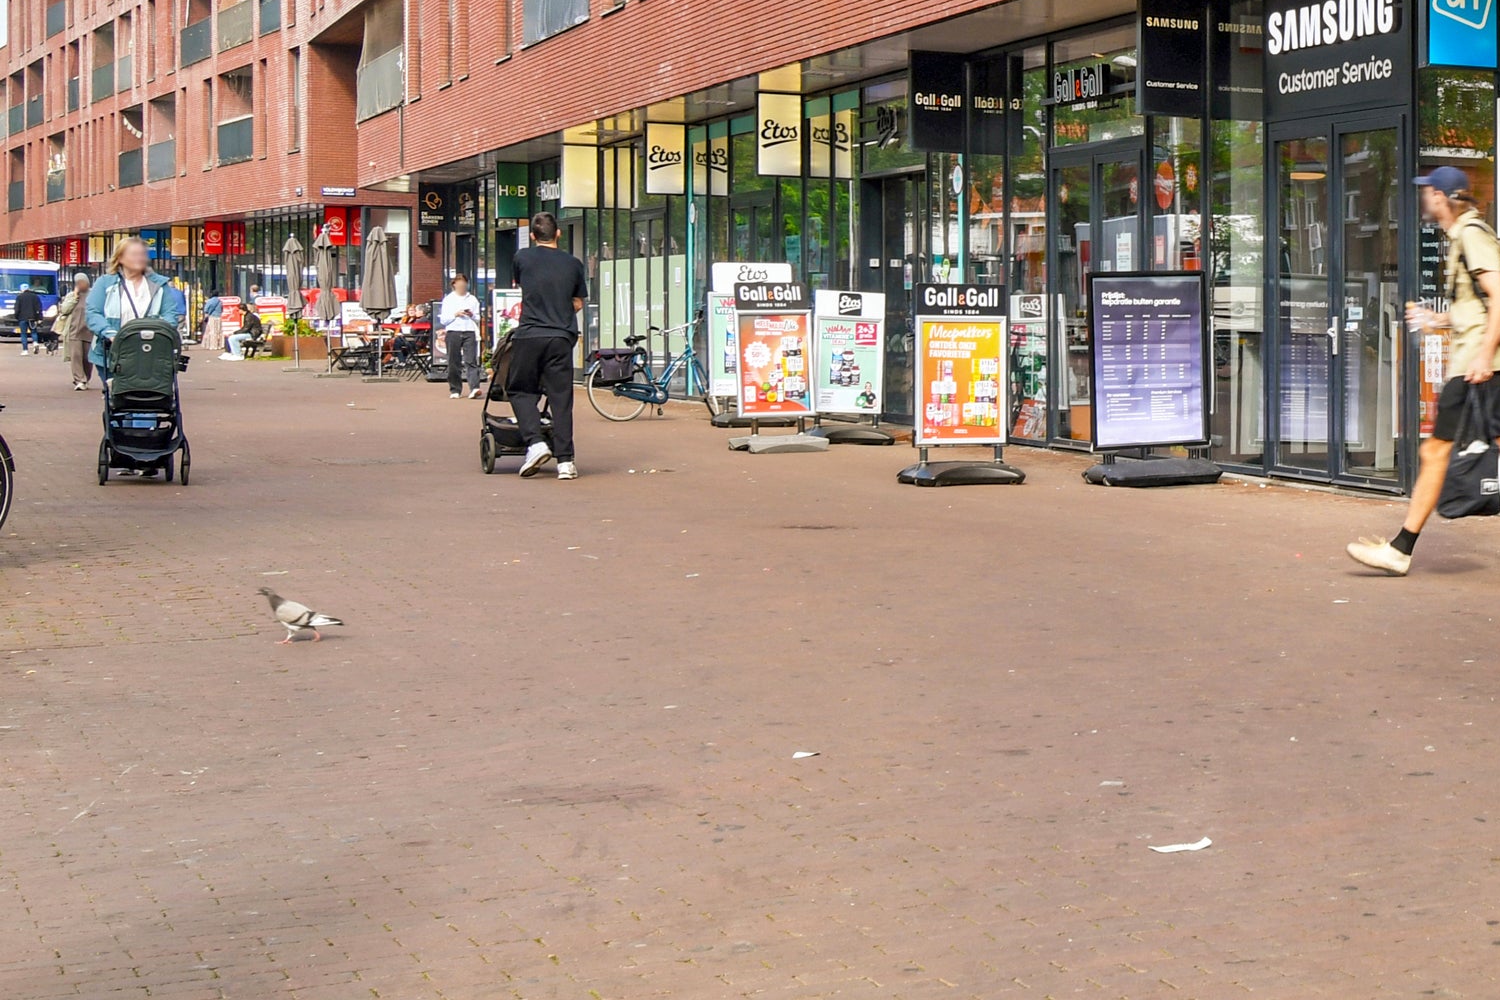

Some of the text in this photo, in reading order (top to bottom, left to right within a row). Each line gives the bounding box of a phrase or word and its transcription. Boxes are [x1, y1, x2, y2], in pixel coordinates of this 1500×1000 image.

[1146, 16, 1199, 30] SAMSUNG
[1054, 63, 1104, 103] Gall&Gall
[1279, 55, 1392, 94] Customer Service
[1146, 80, 1199, 90] Customer Service
[915, 92, 962, 108] Gall&Gall
[761, 119, 798, 140] Etos
[649, 145, 682, 164] Etos
[69, 240, 78, 264] HEMA
[737, 264, 768, 281] Etos
[739, 284, 802, 302] Gall&Gall
[840, 294, 861, 308] Etos
[924, 287, 999, 307] Gall&Gall
[1101, 298, 1132, 307] Reparatie
[1153, 299, 1181, 307] garantie
[857, 324, 876, 334] 2+3
